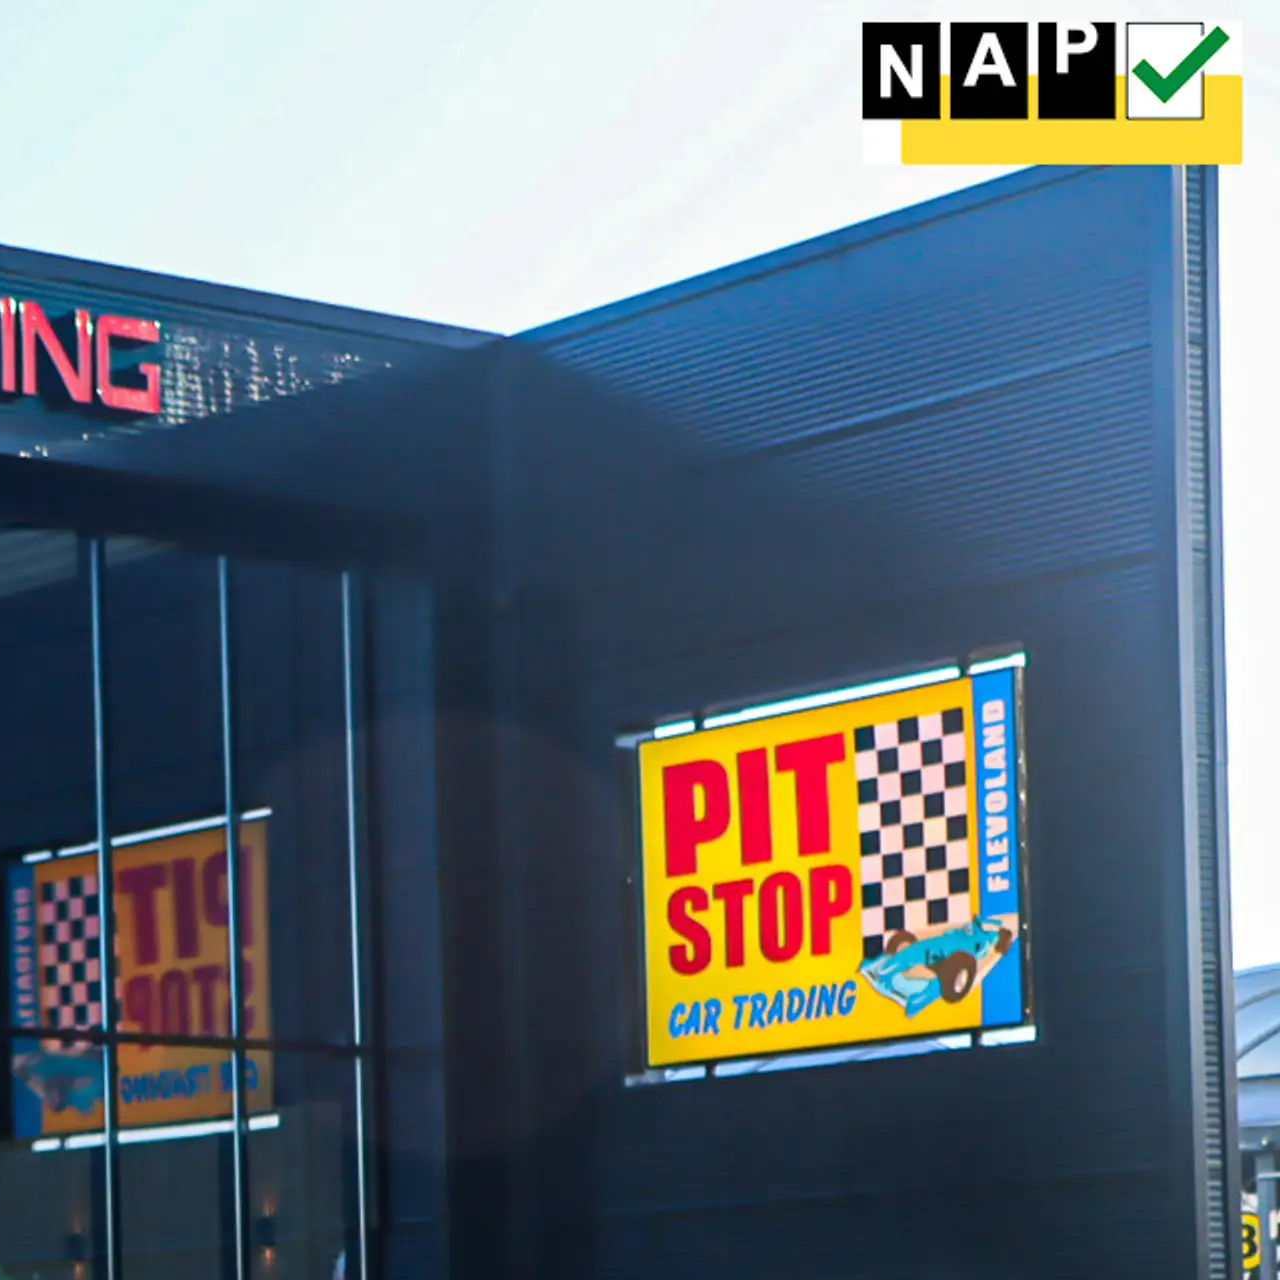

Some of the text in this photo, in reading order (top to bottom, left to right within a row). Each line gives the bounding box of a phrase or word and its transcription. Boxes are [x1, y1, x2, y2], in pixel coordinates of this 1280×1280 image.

[662, 732, 846, 878] PIT
[982, 698, 1011, 893] FLEVOLAND
[667, 863, 854, 976] STOP
[667, 979, 857, 1038] CAR TRADING
